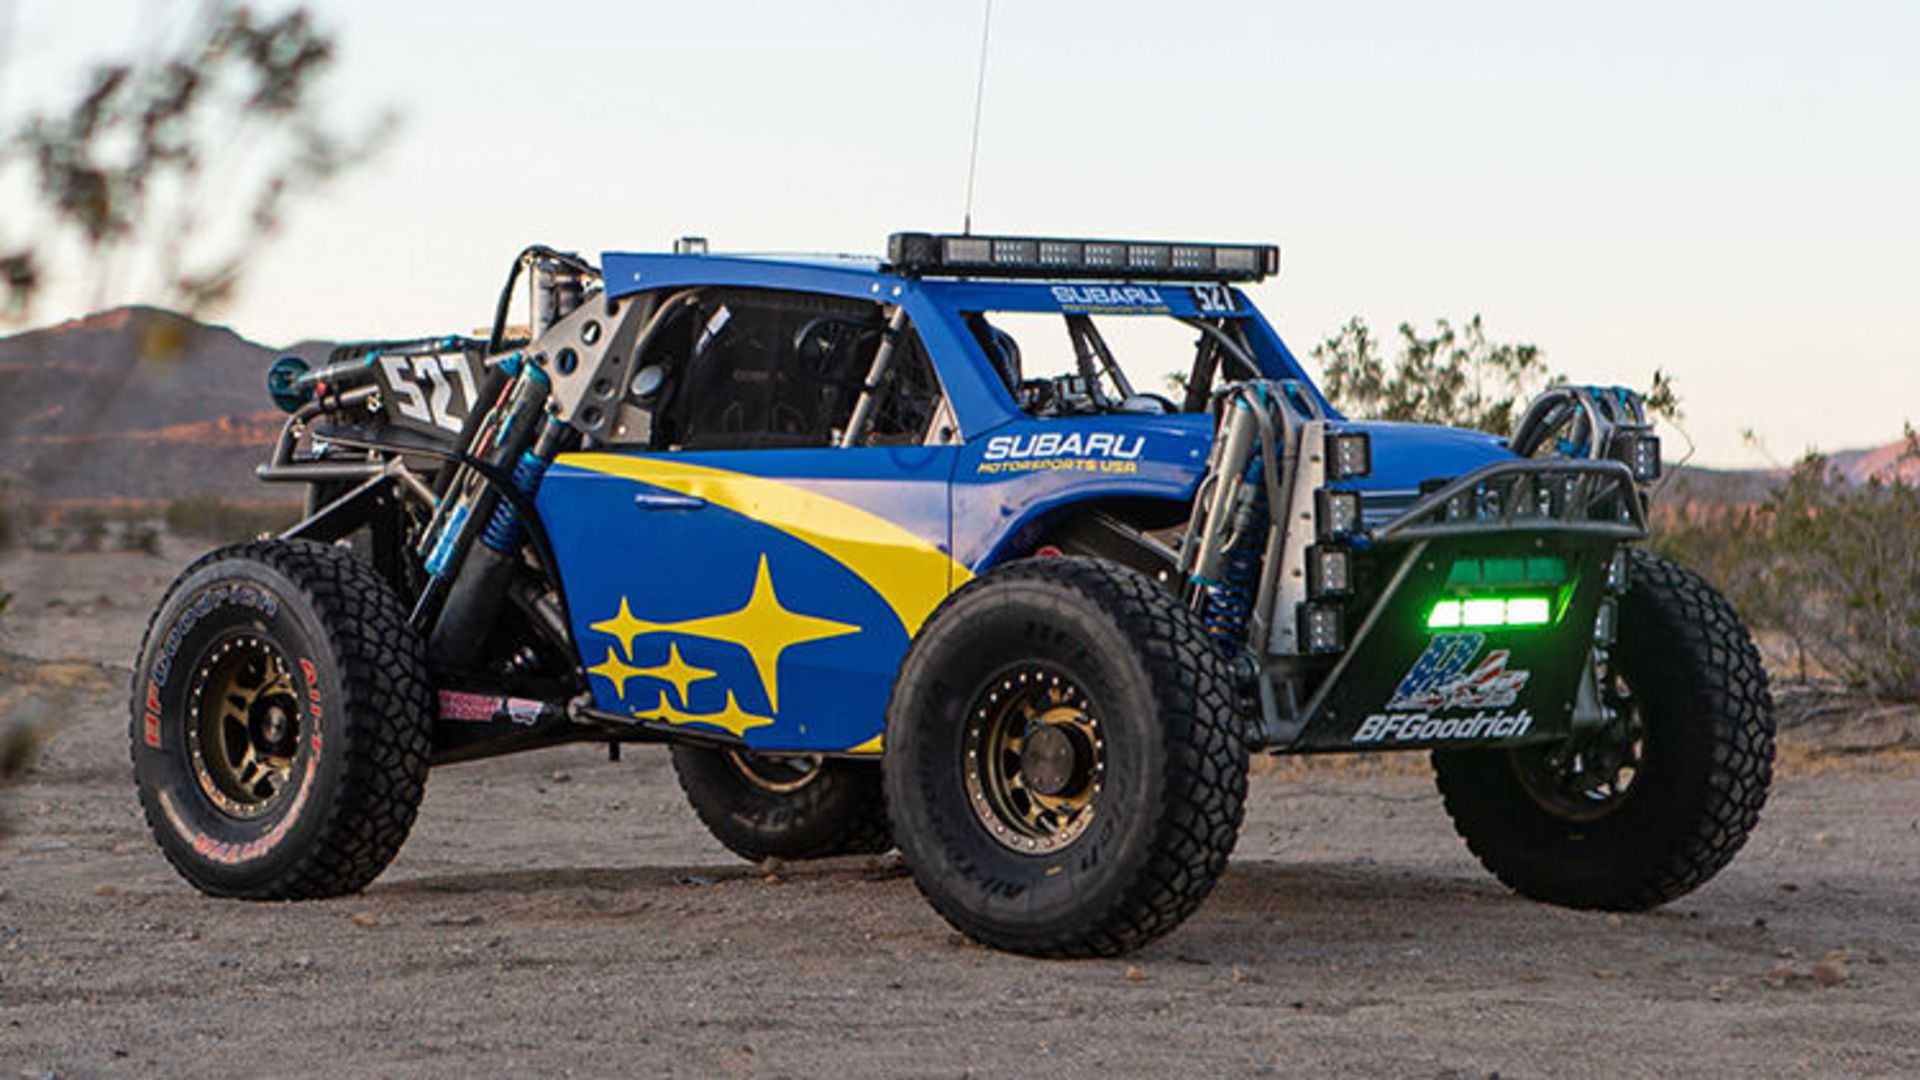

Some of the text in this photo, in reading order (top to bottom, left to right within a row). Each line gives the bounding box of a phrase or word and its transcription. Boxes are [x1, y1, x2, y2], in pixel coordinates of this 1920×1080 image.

[1050, 286, 1163, 305] SUBARU
[1194, 285, 1236, 312] 527
[379, 352, 479, 434] 527
[984, 433, 1146, 459] SUBARU
[977, 459, 1138, 475] MOTORSPORTS USA
[1351, 709, 1534, 743] BFGoodrich
